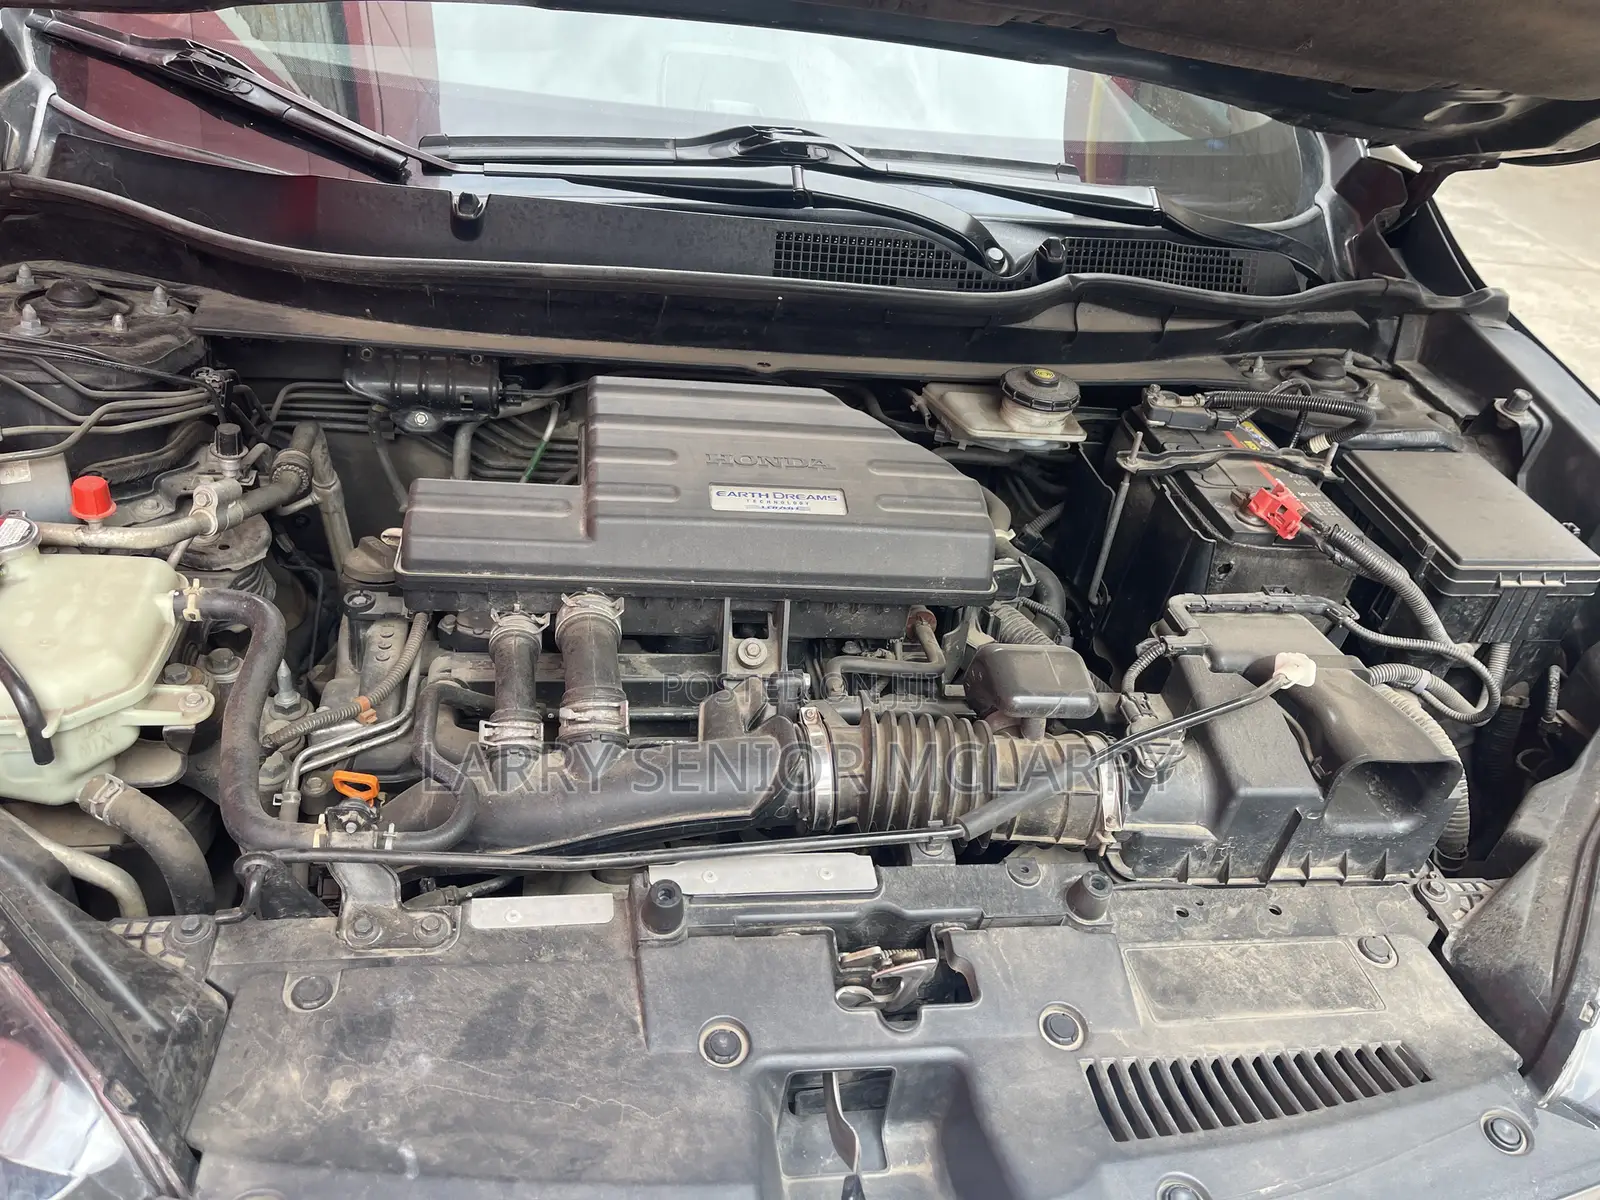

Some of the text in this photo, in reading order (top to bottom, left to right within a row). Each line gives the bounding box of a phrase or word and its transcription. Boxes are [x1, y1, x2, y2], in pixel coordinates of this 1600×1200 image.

[705, 453, 836, 471] HONDA
[716, 490, 838, 501] EARTH DREAMS
